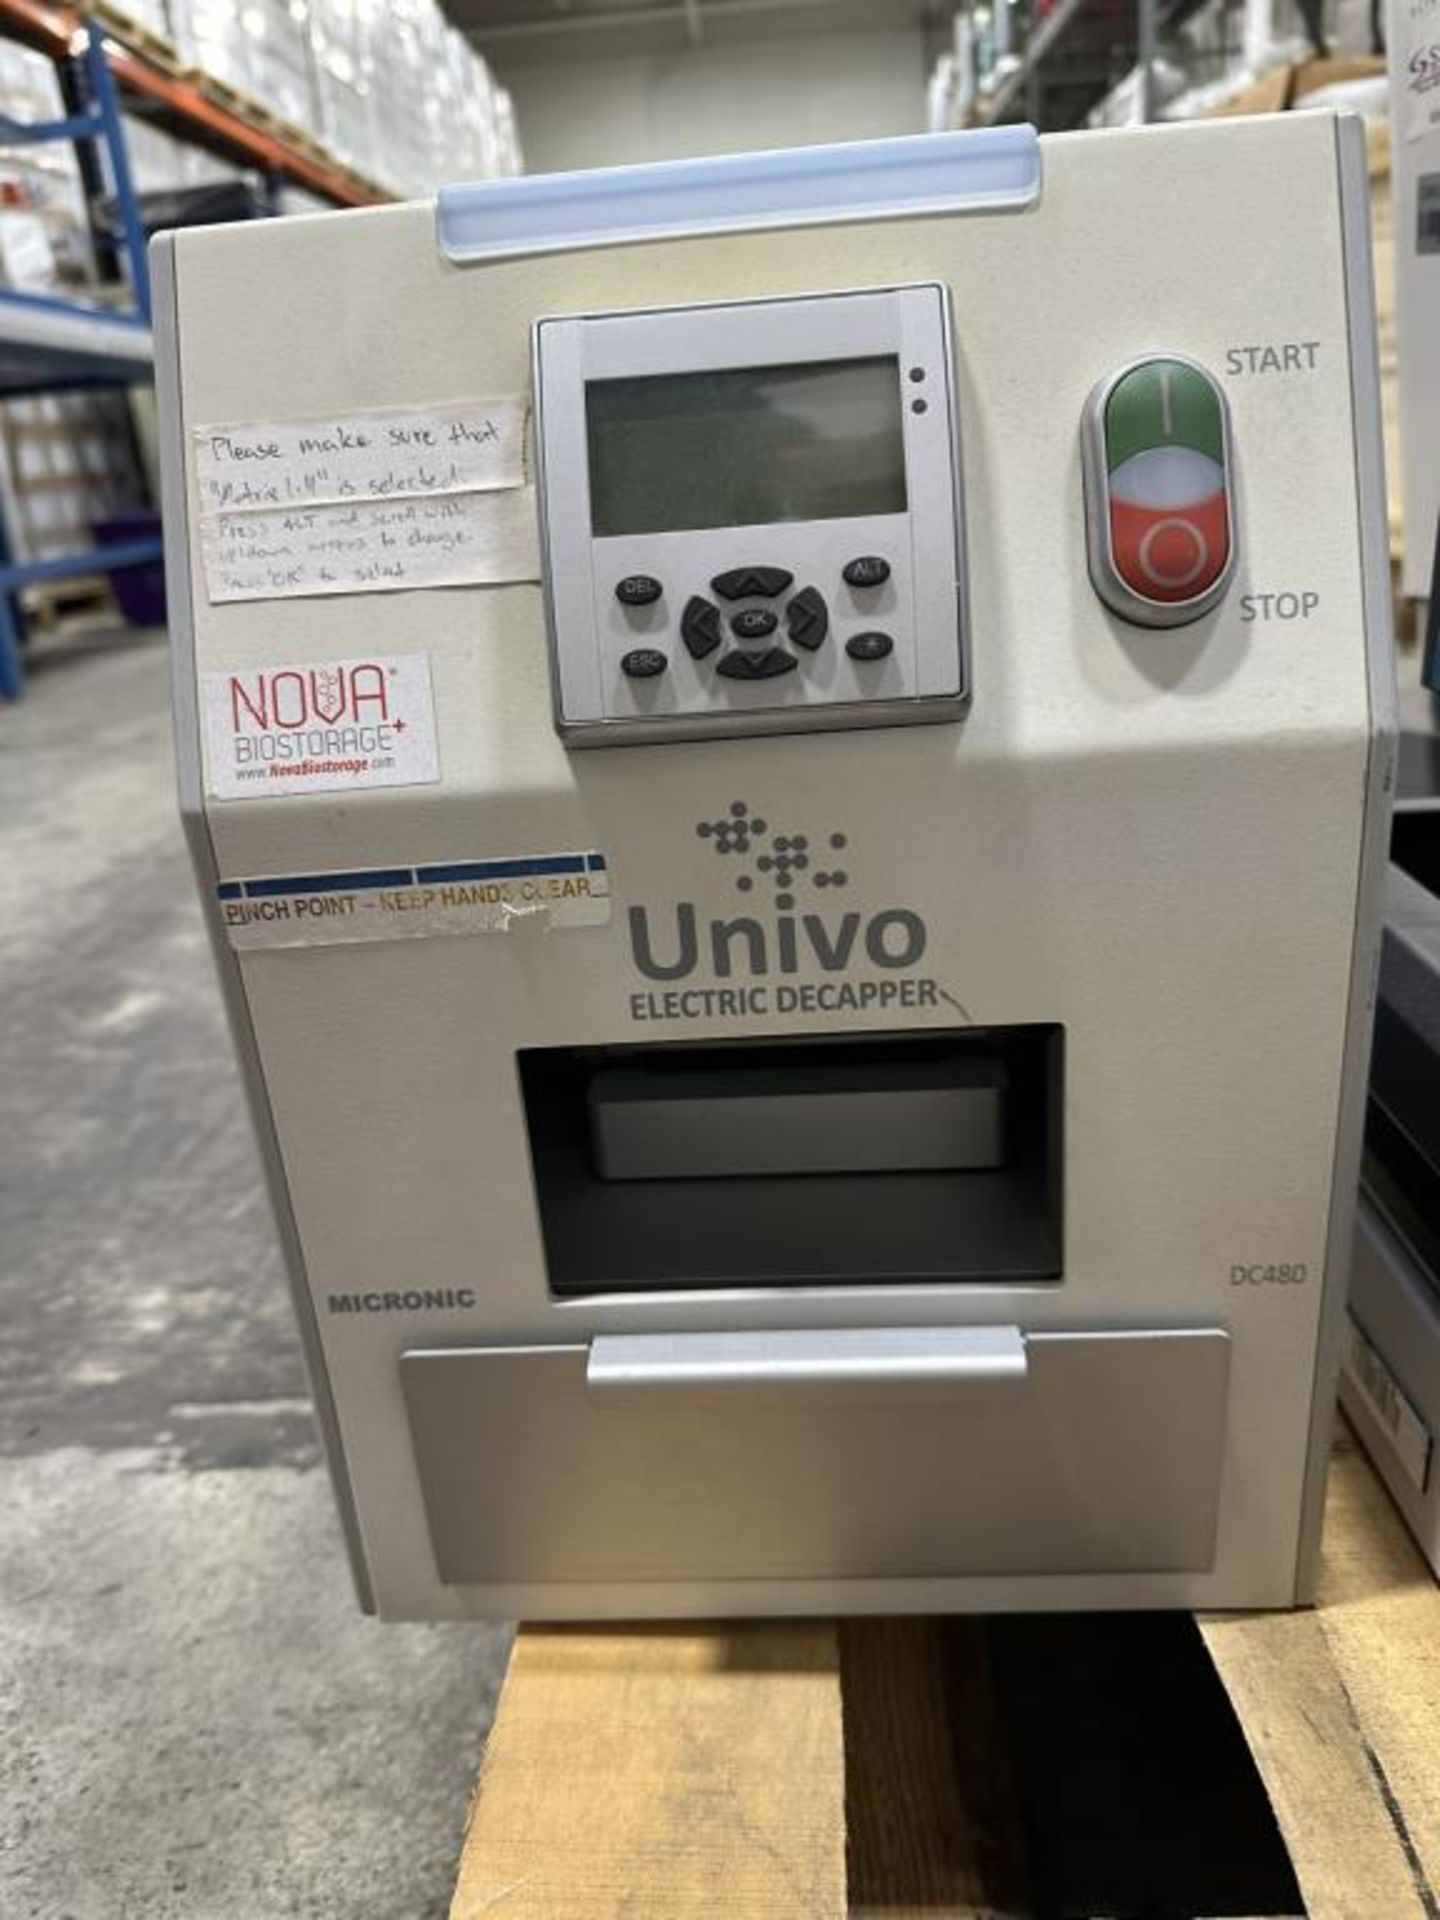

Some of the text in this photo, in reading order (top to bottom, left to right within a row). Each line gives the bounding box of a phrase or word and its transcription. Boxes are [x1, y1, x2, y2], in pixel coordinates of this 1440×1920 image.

[1226, 342, 1320, 375] START
[211, 419, 500, 461] Please make sure that
[339, 476, 355, 496] is
[381, 531, 397, 547] to
[319, 567, 338, 581] to
[852, 558, 883, 578] ALT
[624, 577, 656, 596] DEL
[1240, 591, 1319, 622] STOP
[743, 612, 767, 628] OK
[628, 652, 662, 669] ESC
[230, 664, 388, 732] NOVA
[226, 899, 290, 922] PINCH
[294, 895, 358, 918] POINT
[628, 894, 927, 981] Univo
[629, 979, 938, 1021] ELECTRIC DECAPPER
[1230, 1264, 1307, 1286] DC480
[328, 1289, 476, 1314] MICRONIC
